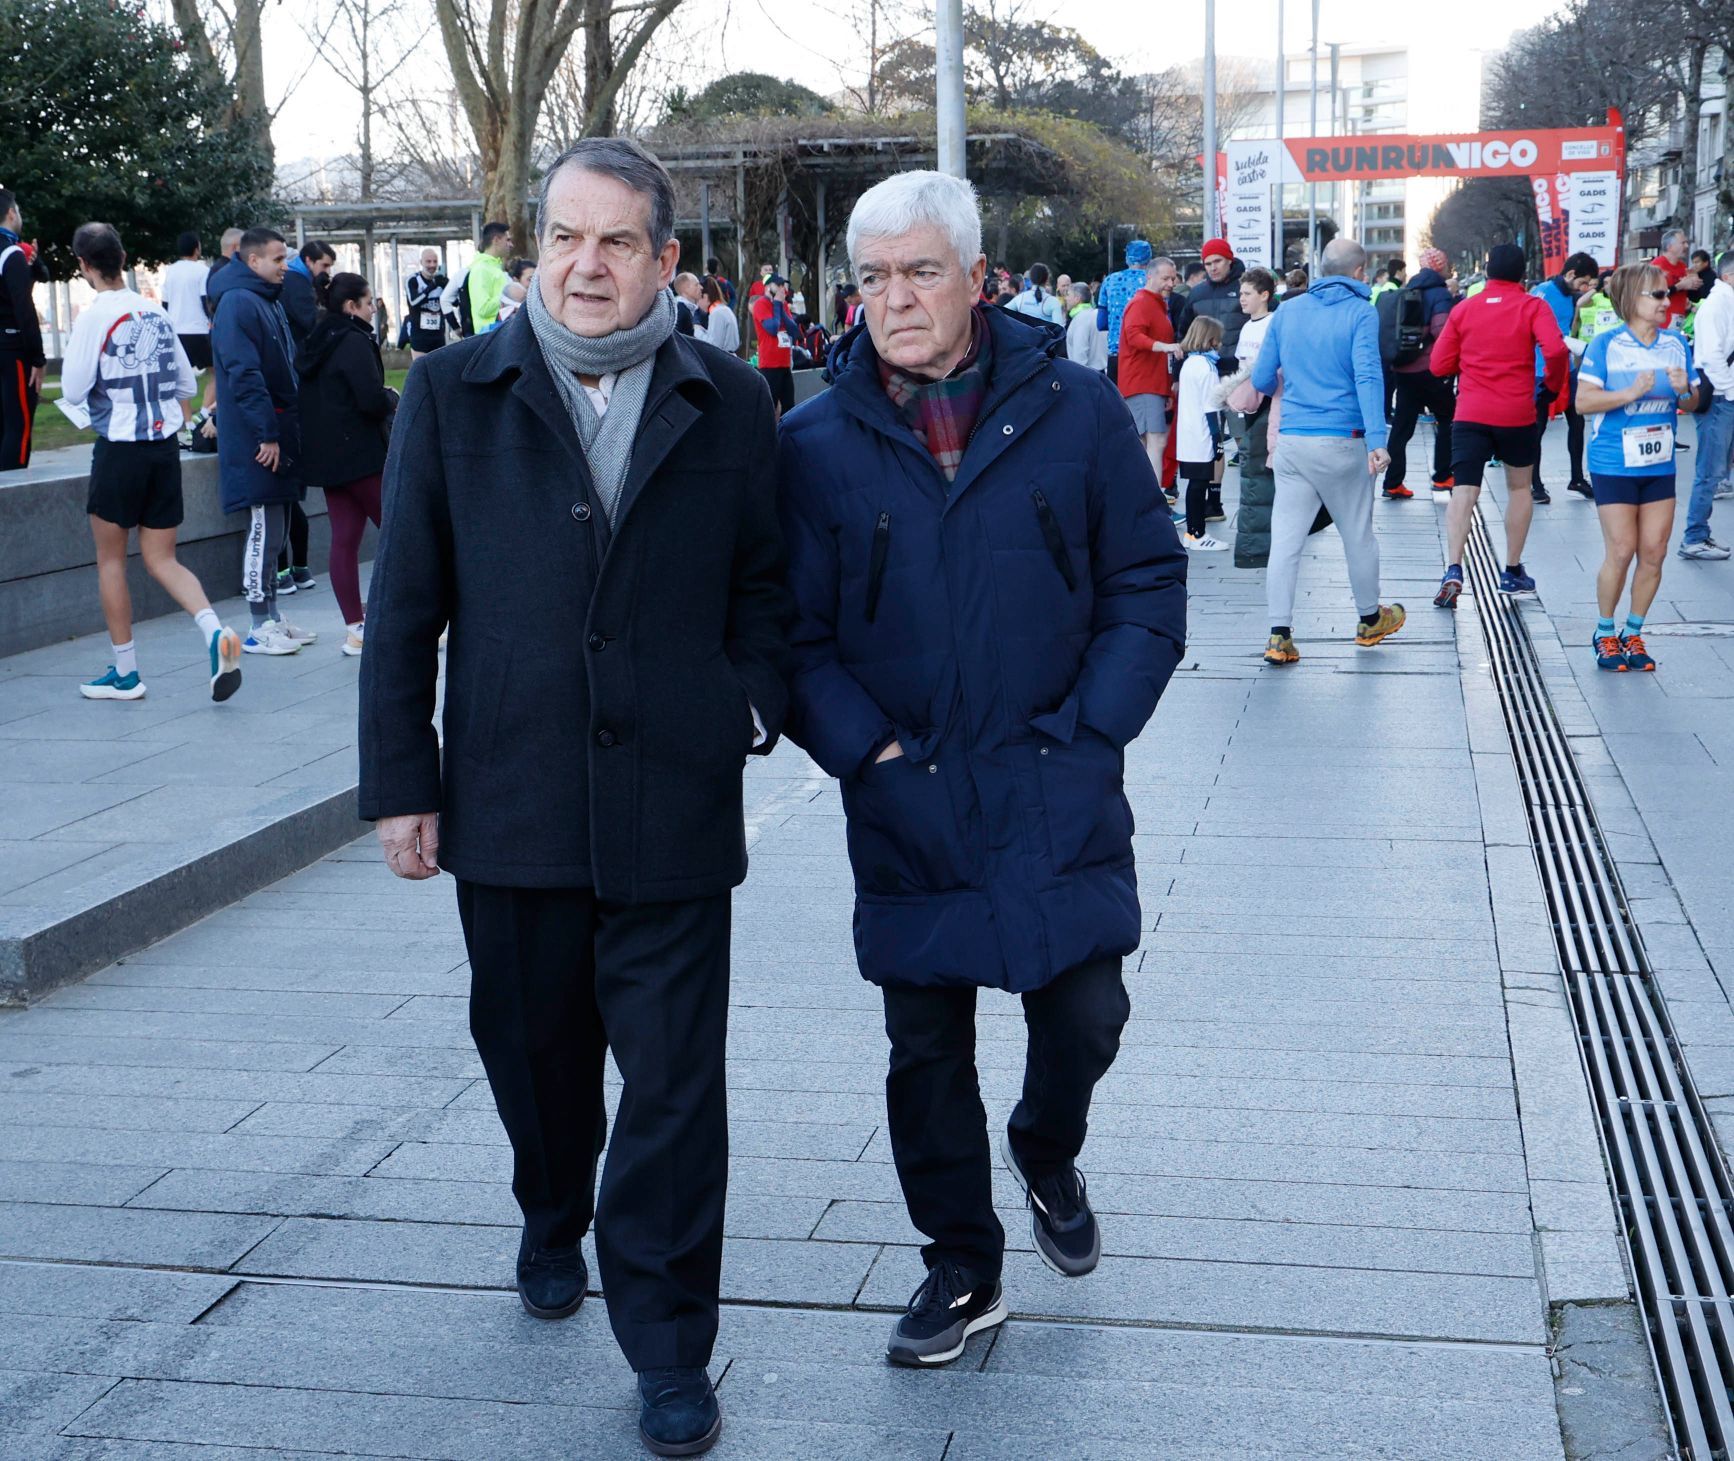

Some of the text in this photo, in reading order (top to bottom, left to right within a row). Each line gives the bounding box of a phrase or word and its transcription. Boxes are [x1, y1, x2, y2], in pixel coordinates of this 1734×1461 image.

[1579, 189, 1607, 197] GADIS
[1578, 231, 1606, 239] GADIS
[1638, 440, 1662, 456] 180
[251, 522, 263, 557] umbro
